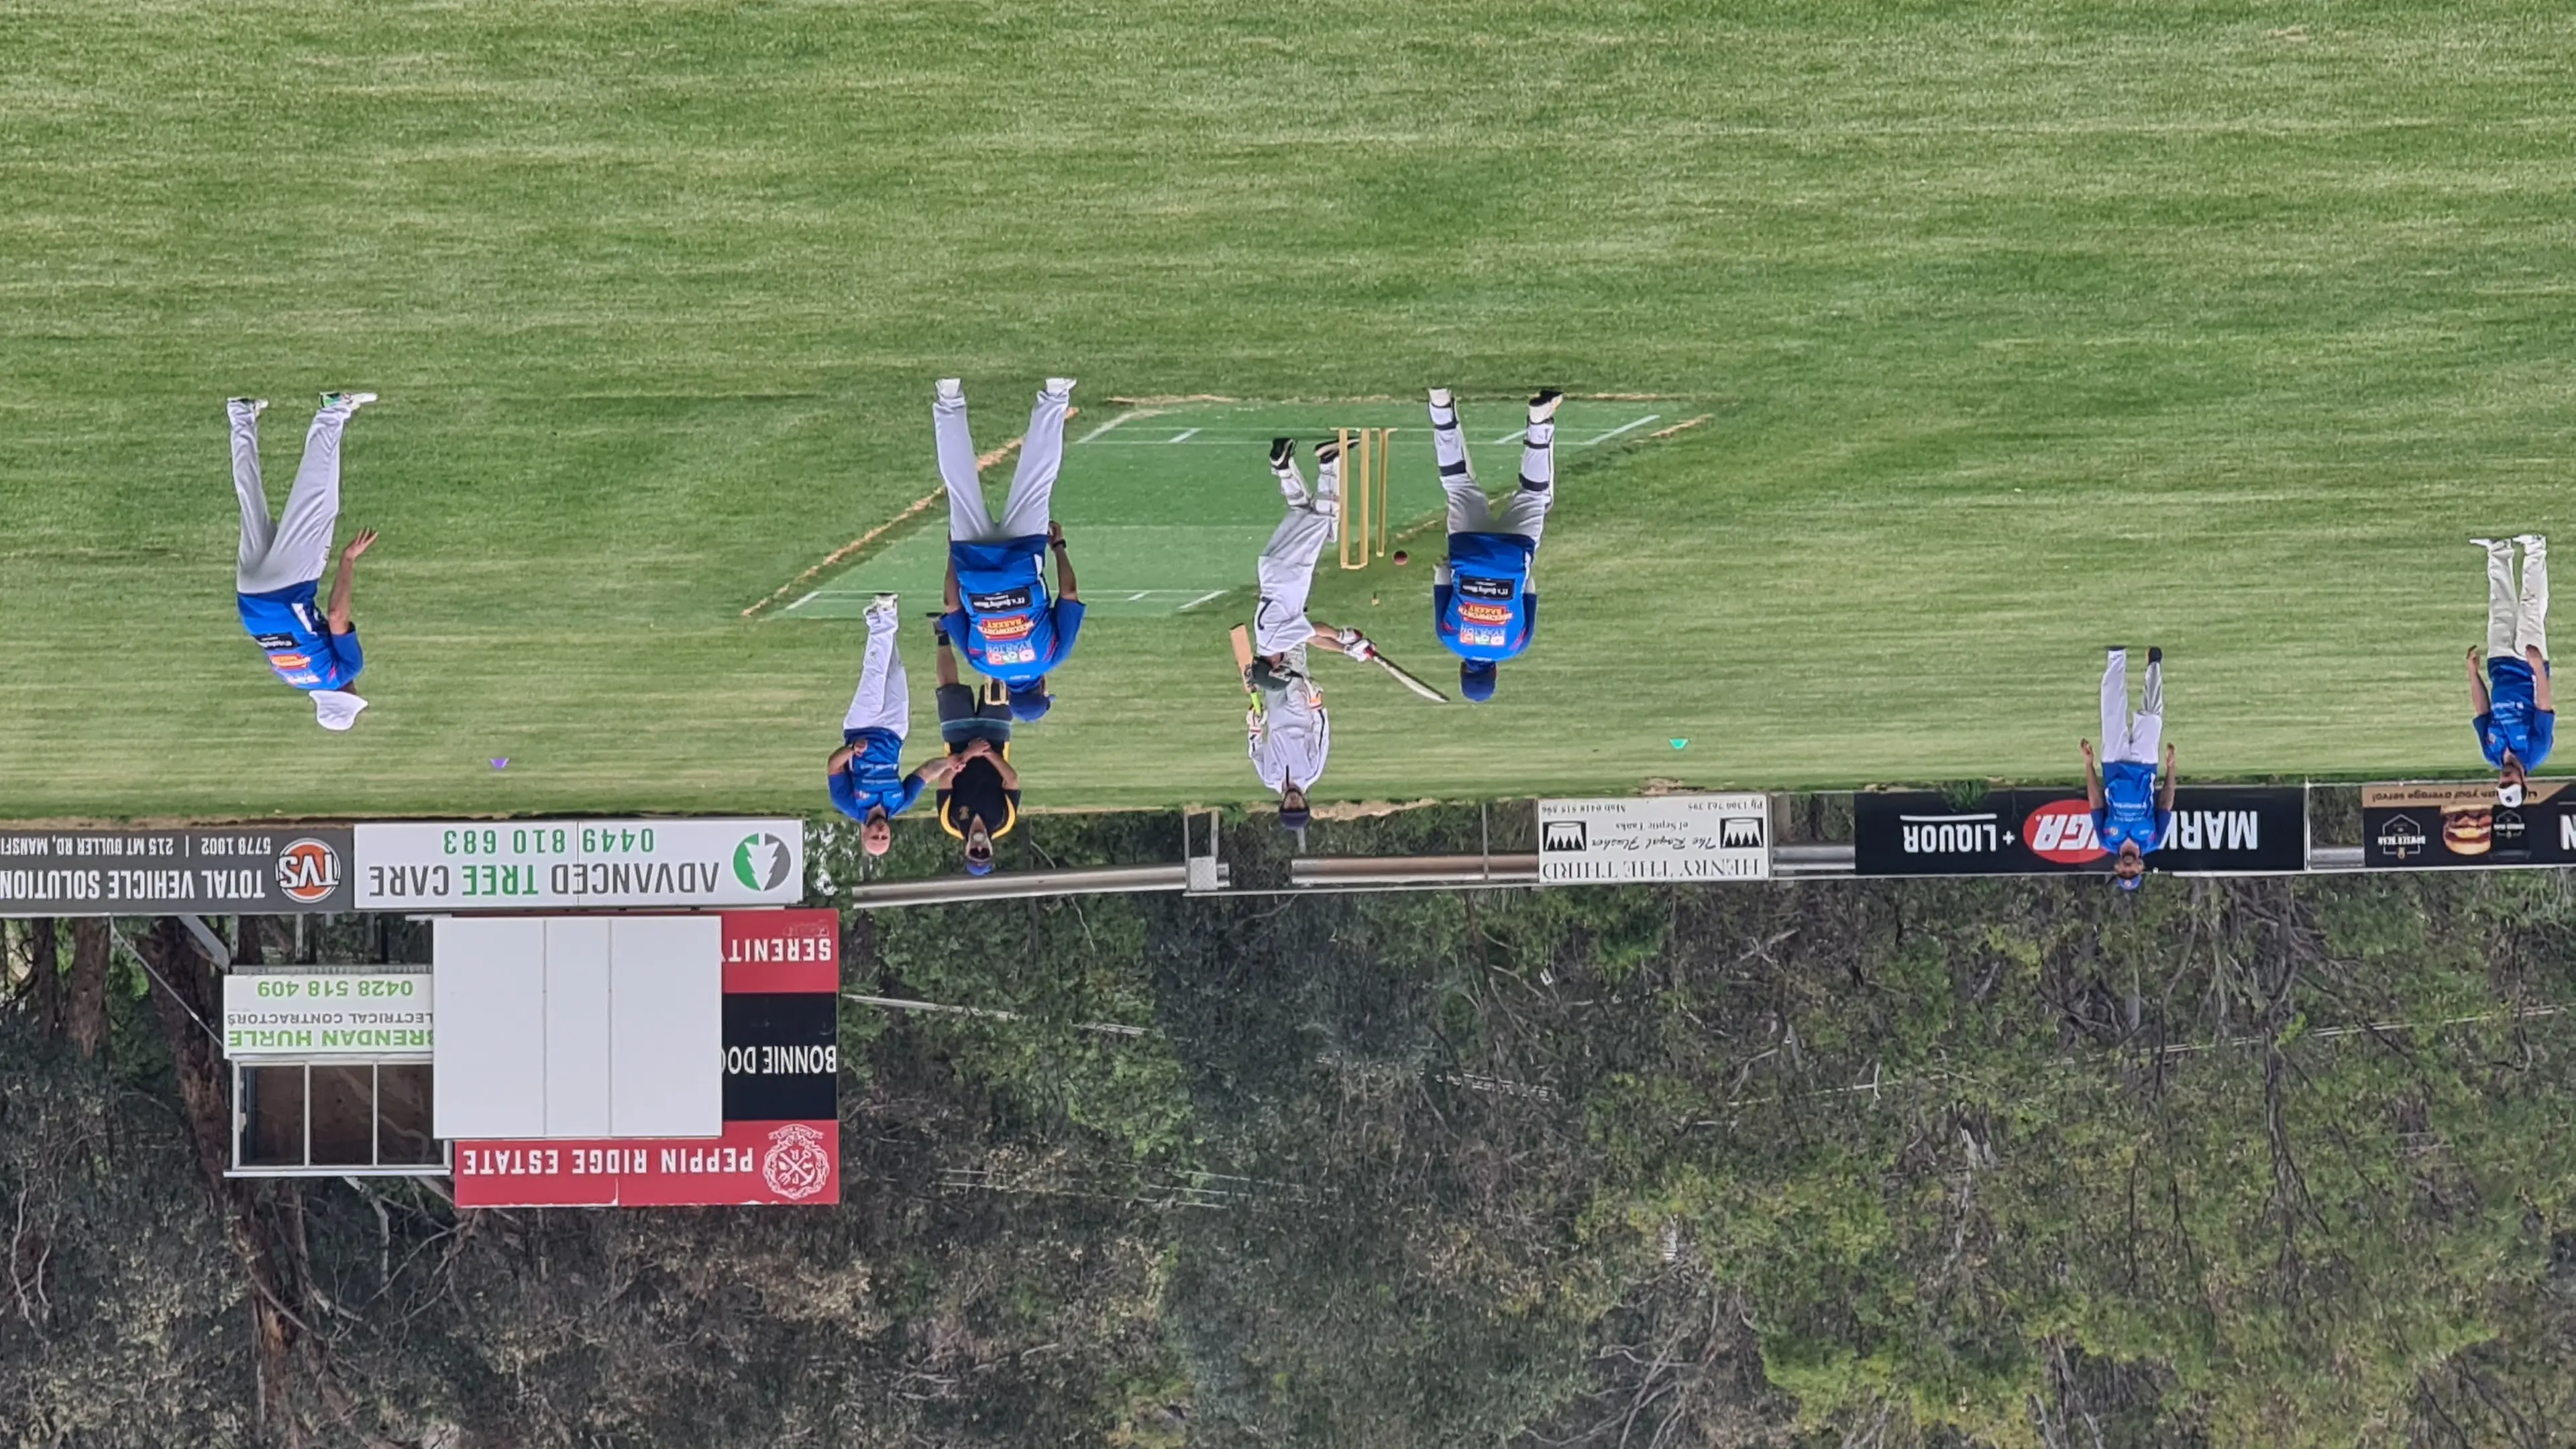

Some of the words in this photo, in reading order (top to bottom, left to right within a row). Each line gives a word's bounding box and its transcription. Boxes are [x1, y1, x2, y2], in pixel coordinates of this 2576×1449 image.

[1256, 596, 1273, 631] 2
[2408, 790, 2453, 800] average
[125, 837, 145, 856] MT
[148, 837, 174, 856] 215
[443, 829, 496, 855] 683
[513, 828, 566, 854] 810
[582, 828, 654, 853] 0449
[1591, 836, 1640, 852] Flusher
[1644, 835, 1686, 850] Royal
[1692, 837, 1717, 850] The
[1902, 824, 1997, 853] LIQUOR
[277, 853, 339, 888] TVS
[551, 863, 719, 894] ADVANCED
[1542, 861, 1618, 880] THIRD
[1623, 860, 1674, 878] THE
[1678, 858, 1760, 877] HENRY
[107, 869, 195, 900] VEHICLE
[201, 869, 266, 900] TOTAL
[368, 865, 449, 896] CARE
[462, 865, 539, 896] TREE
[256, 981, 299, 998] 409
[307, 981, 349, 997] 518
[358, 980, 414, 997] 0428
[227, 1013, 343, 1026] CONTRACTORS
[348, 1013, 432, 1024] LECTRICAL
[227, 1030, 312, 1048] HURLE
[762, 1045, 837, 1074] BONNIE
[462, 1149, 559, 1175] ESTATE
[572, 1148, 647, 1175] RIDGE
[661, 1148, 754, 1173] PEPPIN
